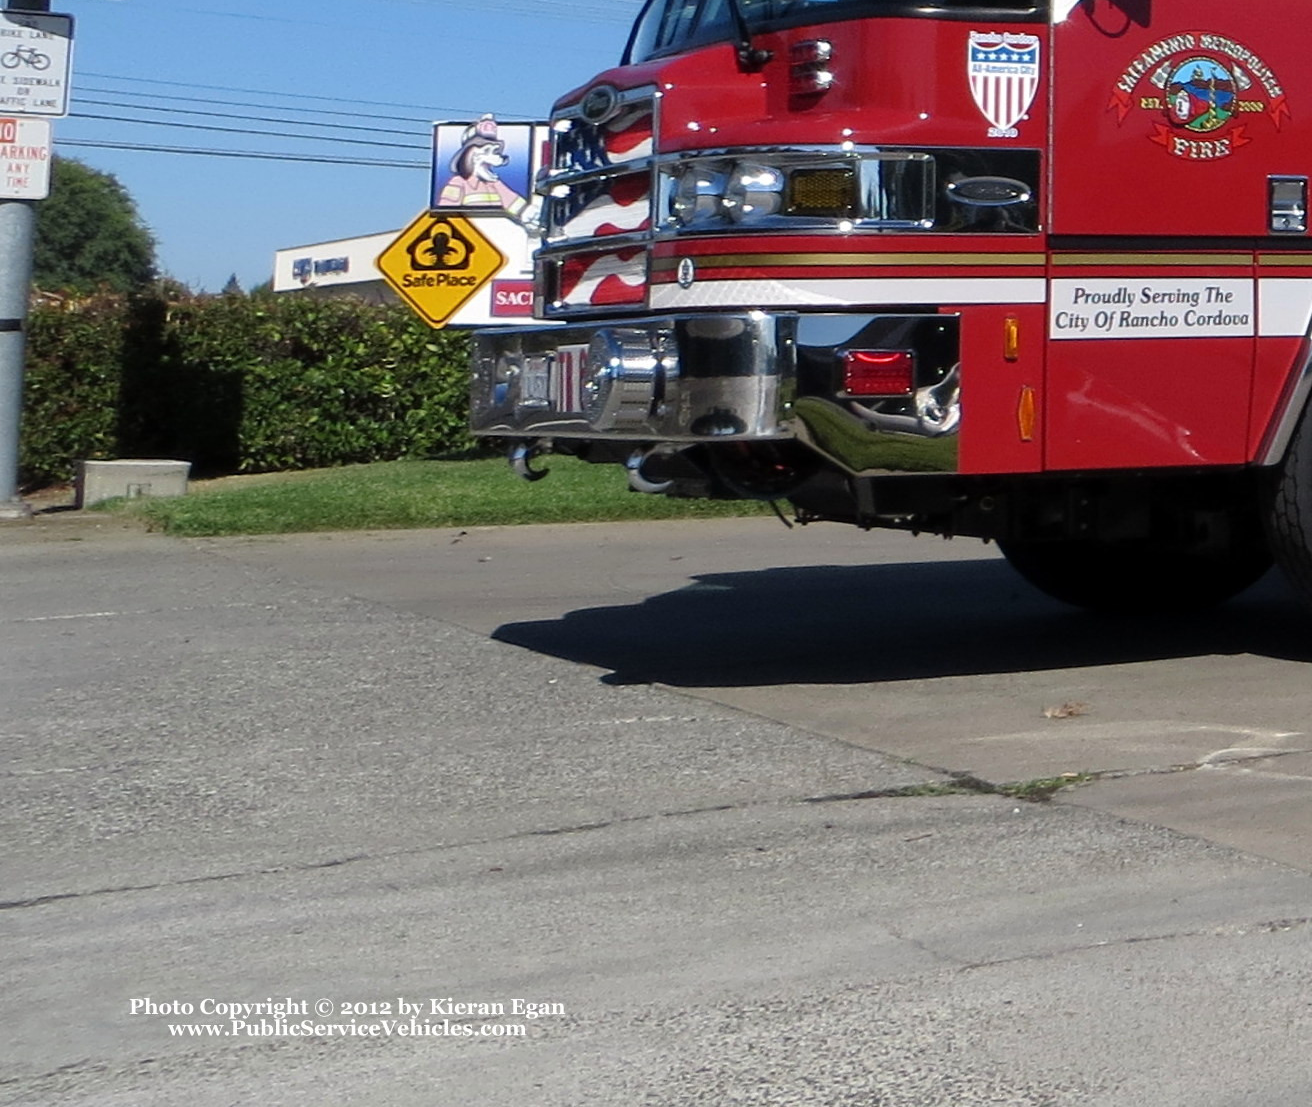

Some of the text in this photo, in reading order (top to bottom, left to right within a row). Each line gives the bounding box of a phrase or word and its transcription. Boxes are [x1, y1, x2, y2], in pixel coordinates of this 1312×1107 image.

[0, 122, 14, 141] O
[0, 146, 48, 161] ARKING
[1172, 136, 1230, 159] FIRE
[7, 162, 29, 173] ANY
[7, 176, 28, 188] TIME
[402, 273, 477, 288] Safe Place
[1073, 286, 1234, 308] Proudly Serving The
[1055, 309, 1250, 332] City Of Rancho Cordova
